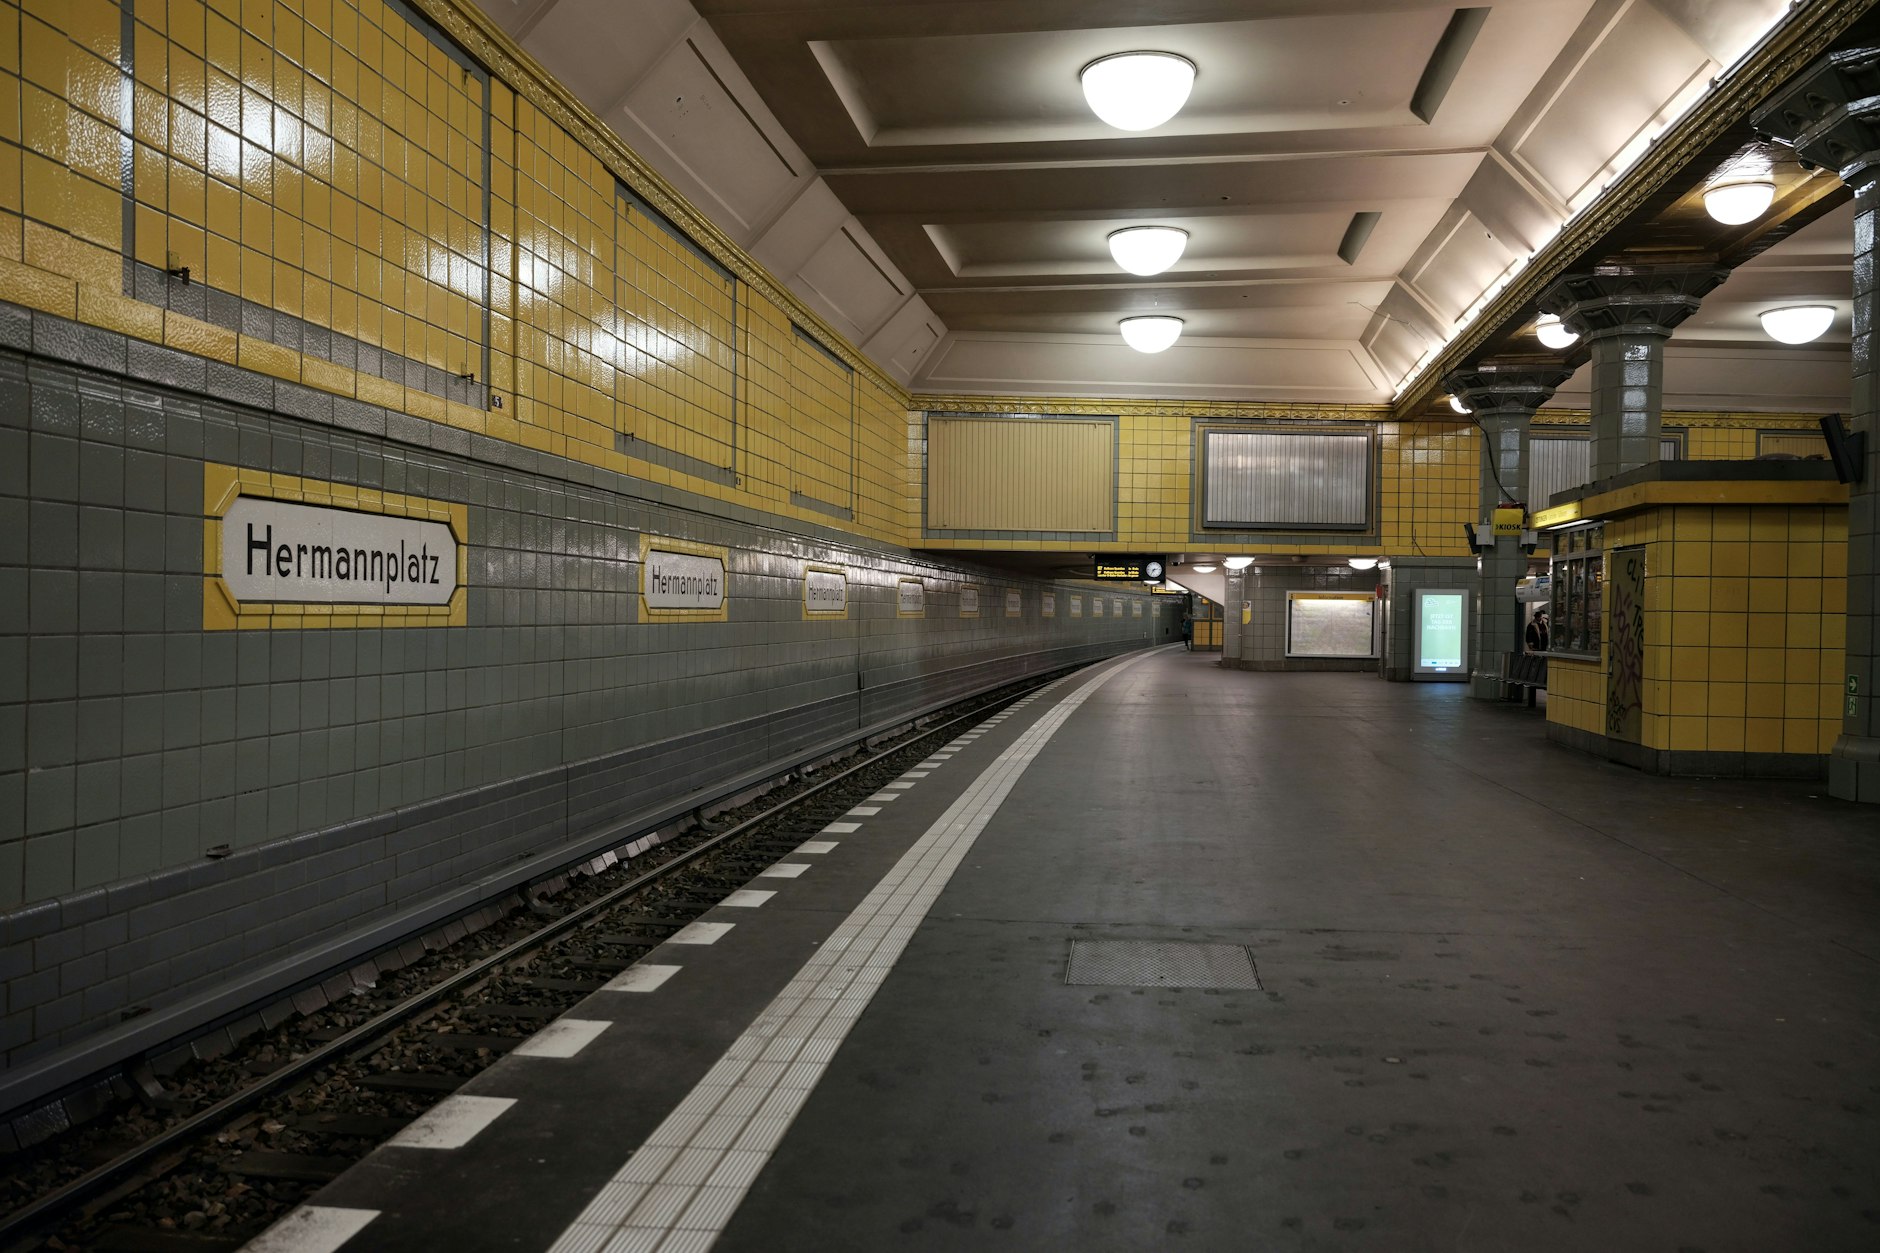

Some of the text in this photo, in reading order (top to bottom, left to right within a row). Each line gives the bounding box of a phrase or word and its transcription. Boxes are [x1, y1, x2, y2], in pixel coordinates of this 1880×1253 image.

[1499, 523, 1521, 531] KIOSK
[247, 522, 440, 594] Hermannplatz
[652, 565, 718, 602] Hermannplatz
